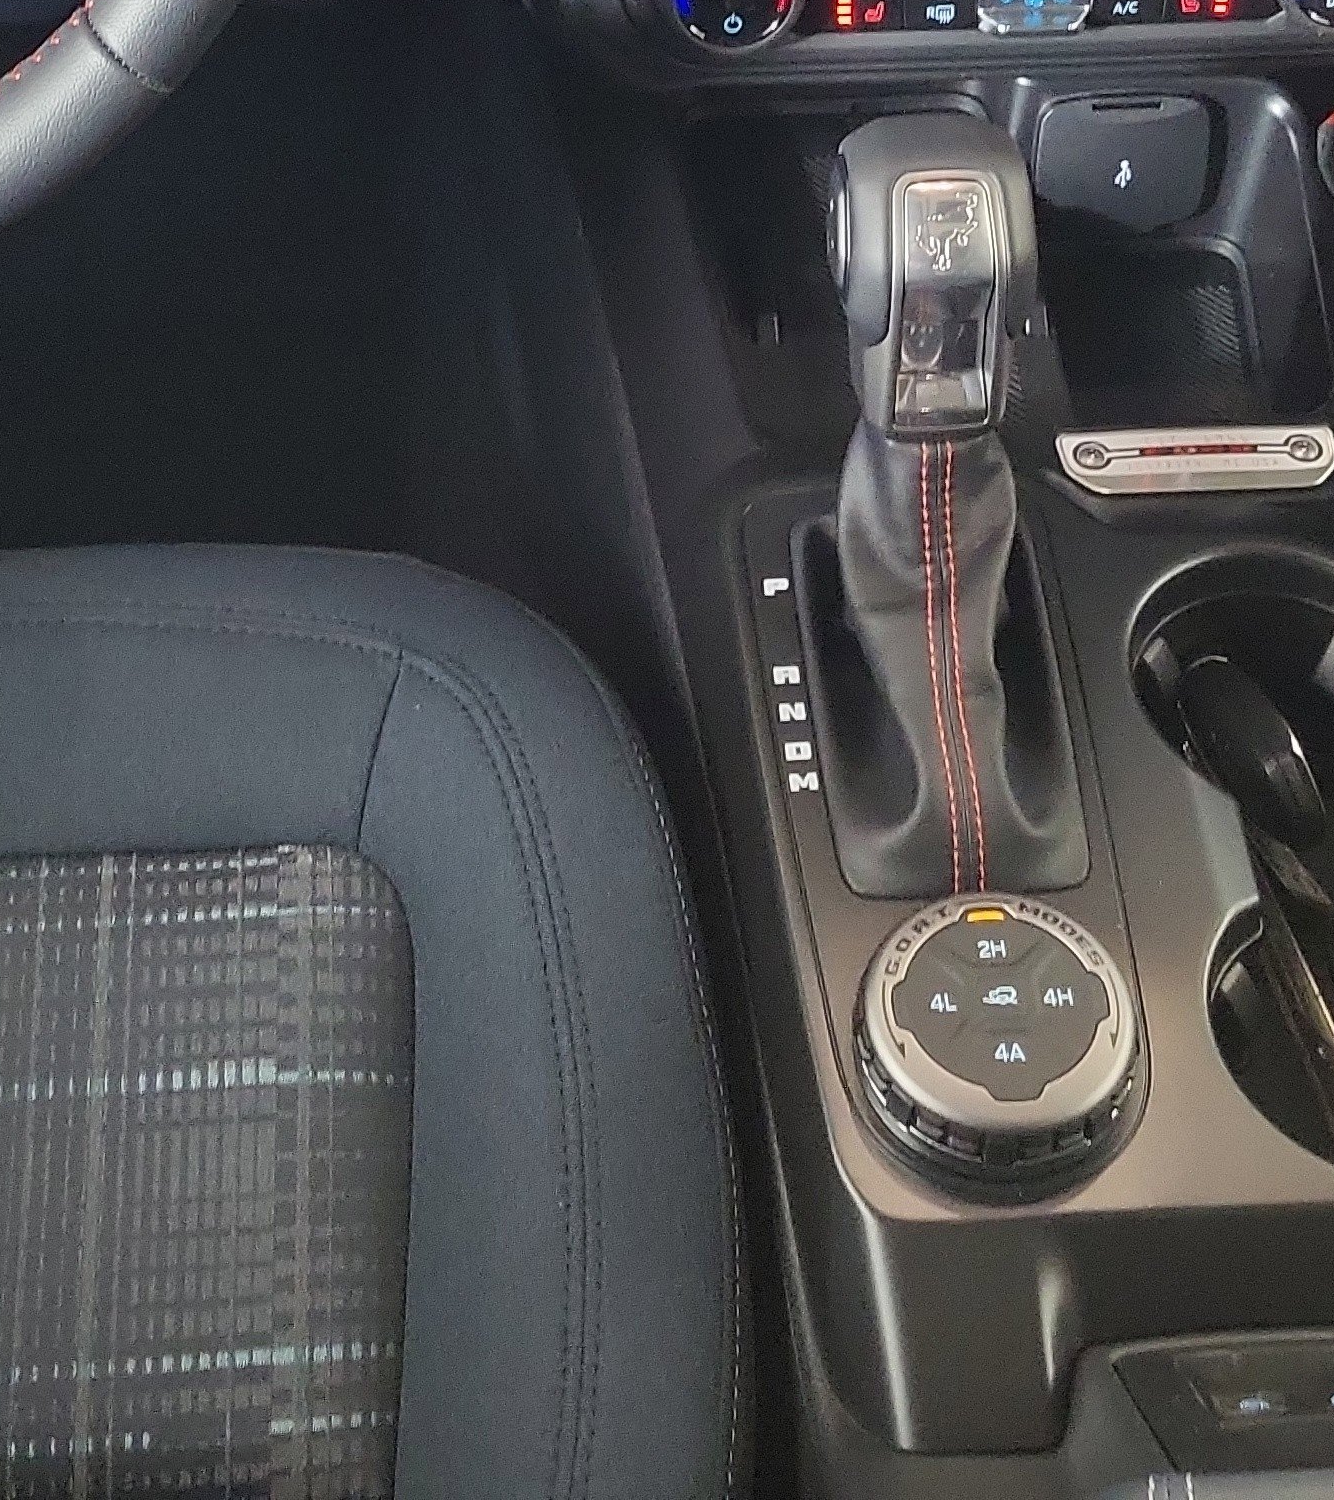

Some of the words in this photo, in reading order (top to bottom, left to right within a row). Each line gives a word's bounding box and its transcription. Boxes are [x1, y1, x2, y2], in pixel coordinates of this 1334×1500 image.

[1113, 0, 1139, 16] A/C
[763, 577, 789, 597] P
[778, 702, 806, 722] N
[784, 741, 812, 761] D
[788, 771, 819, 793] M
[977, 939, 1007, 959] 2H
[930, 993, 957, 1013] 4L
[1043, 987, 1074, 1007] 4H
[994, 1043, 1026, 1063] 4A
